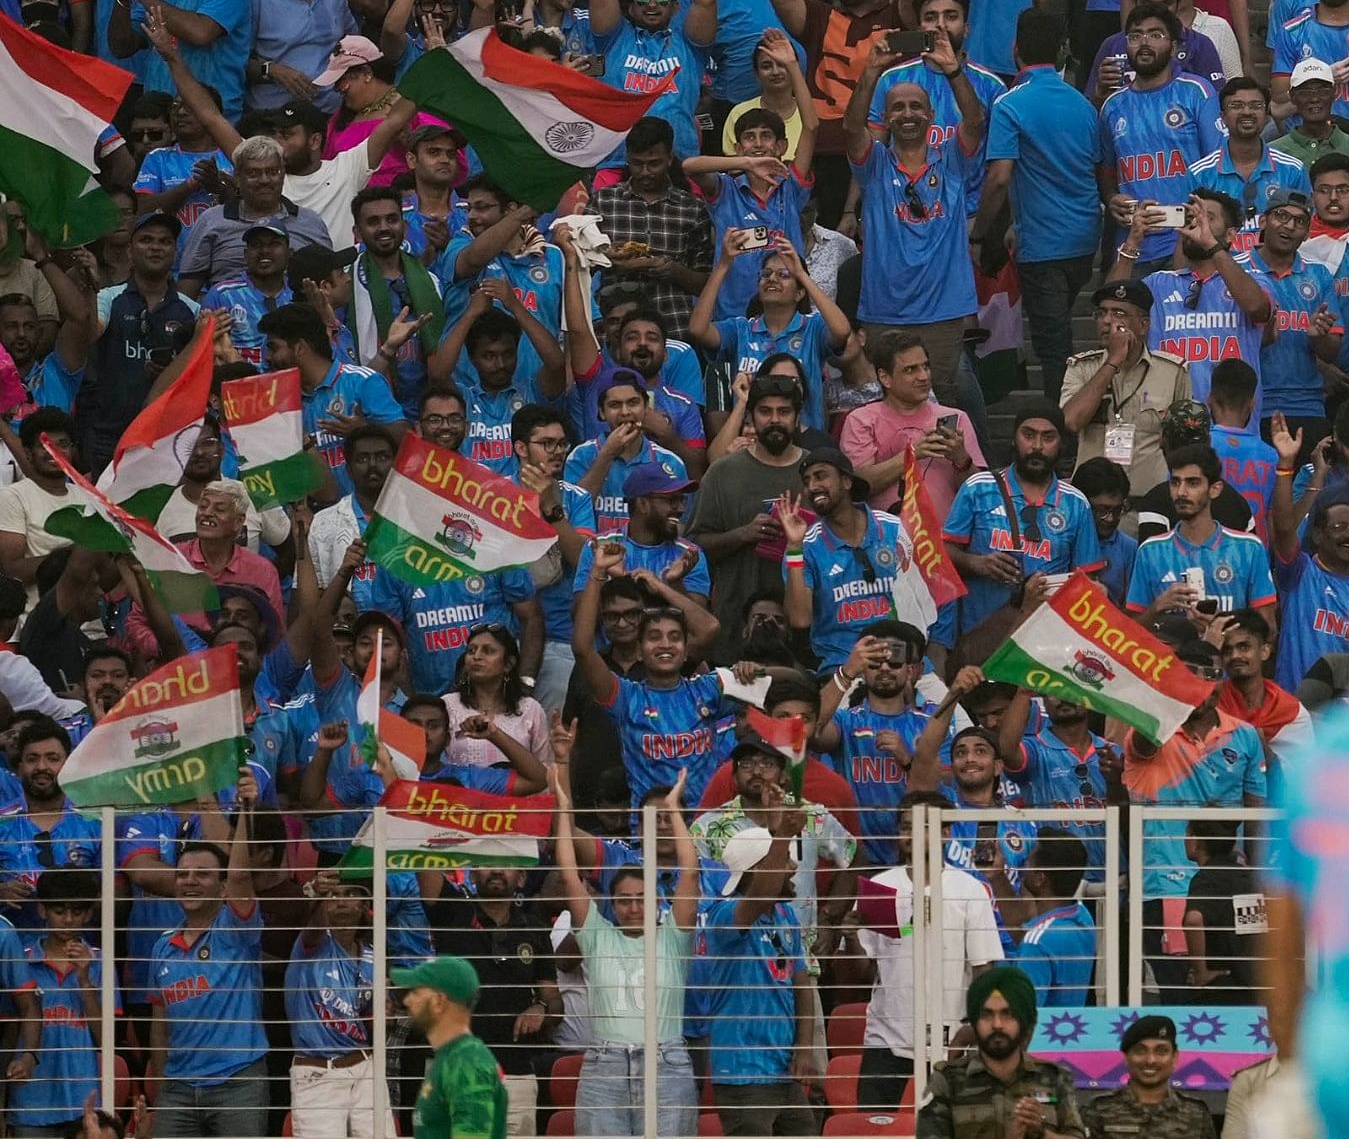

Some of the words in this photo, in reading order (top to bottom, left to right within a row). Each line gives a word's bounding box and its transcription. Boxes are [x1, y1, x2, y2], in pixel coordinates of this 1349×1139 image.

[1117, 150, 1186, 179] NDIA
[1164, 313, 1238, 330] DREAM11
[1160, 336, 1240, 359] INDIA
[422, 453, 526, 527] bharat
[416, 605, 485, 628] DREAM11
[837, 601, 891, 622] INDIA
[1068, 592, 1173, 679] bharat
[406, 787, 517, 834] bharat
[163, 975, 210, 1004] INDIA
